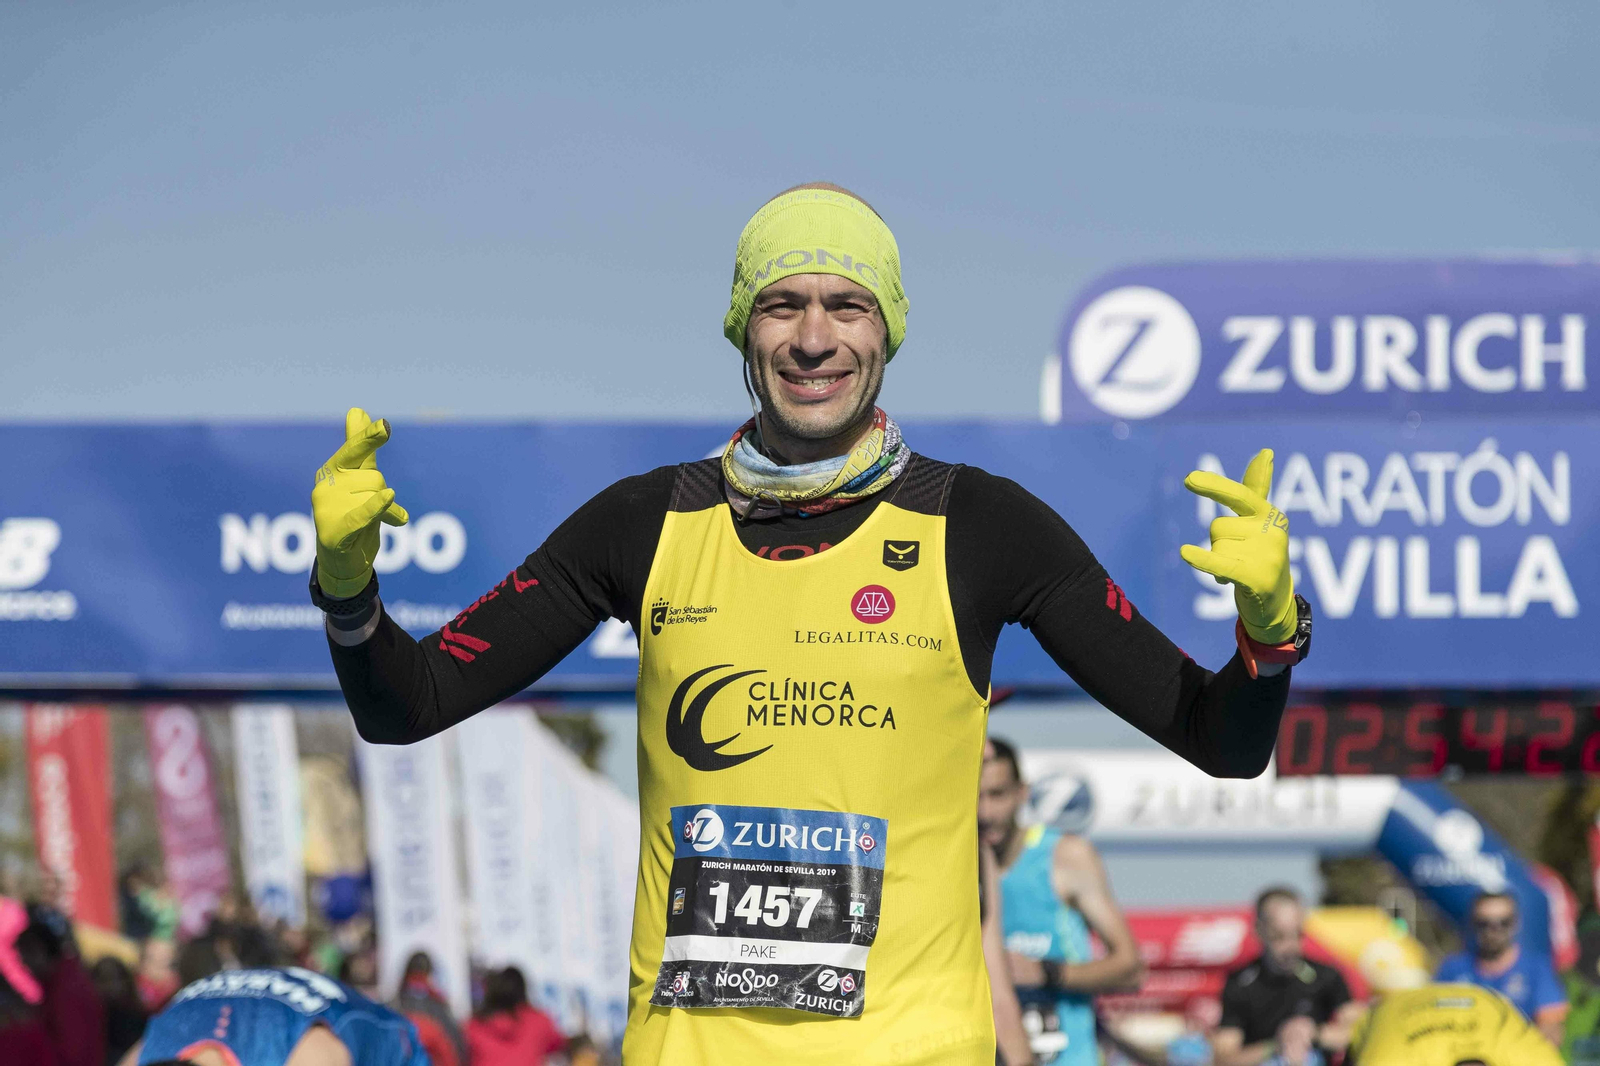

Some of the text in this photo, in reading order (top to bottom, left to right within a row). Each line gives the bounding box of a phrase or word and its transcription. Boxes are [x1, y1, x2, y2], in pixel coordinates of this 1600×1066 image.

[1219, 313, 1587, 394] ZURICH
[1191, 534, 1580, 620] VILLA
[669, 607, 682, 616] San
[685, 615, 707, 624] Reyes
[794, 630, 943, 652] LEGALITAS.COM
[748, 677, 856, 702] CLÍNICA
[746, 704, 897, 731] MENORCA
[732, 821, 858, 852] ZURICH
[701, 861, 731, 870] ZURICH
[732, 863, 772, 873] MARATÓN
[784, 866, 815, 875] SEVILLA
[816, 868, 837, 876] 2019
[709, 882, 823, 929] 1457
[740, 944, 777, 959] PAKE
[795, 993, 853, 1012] ZURICH
